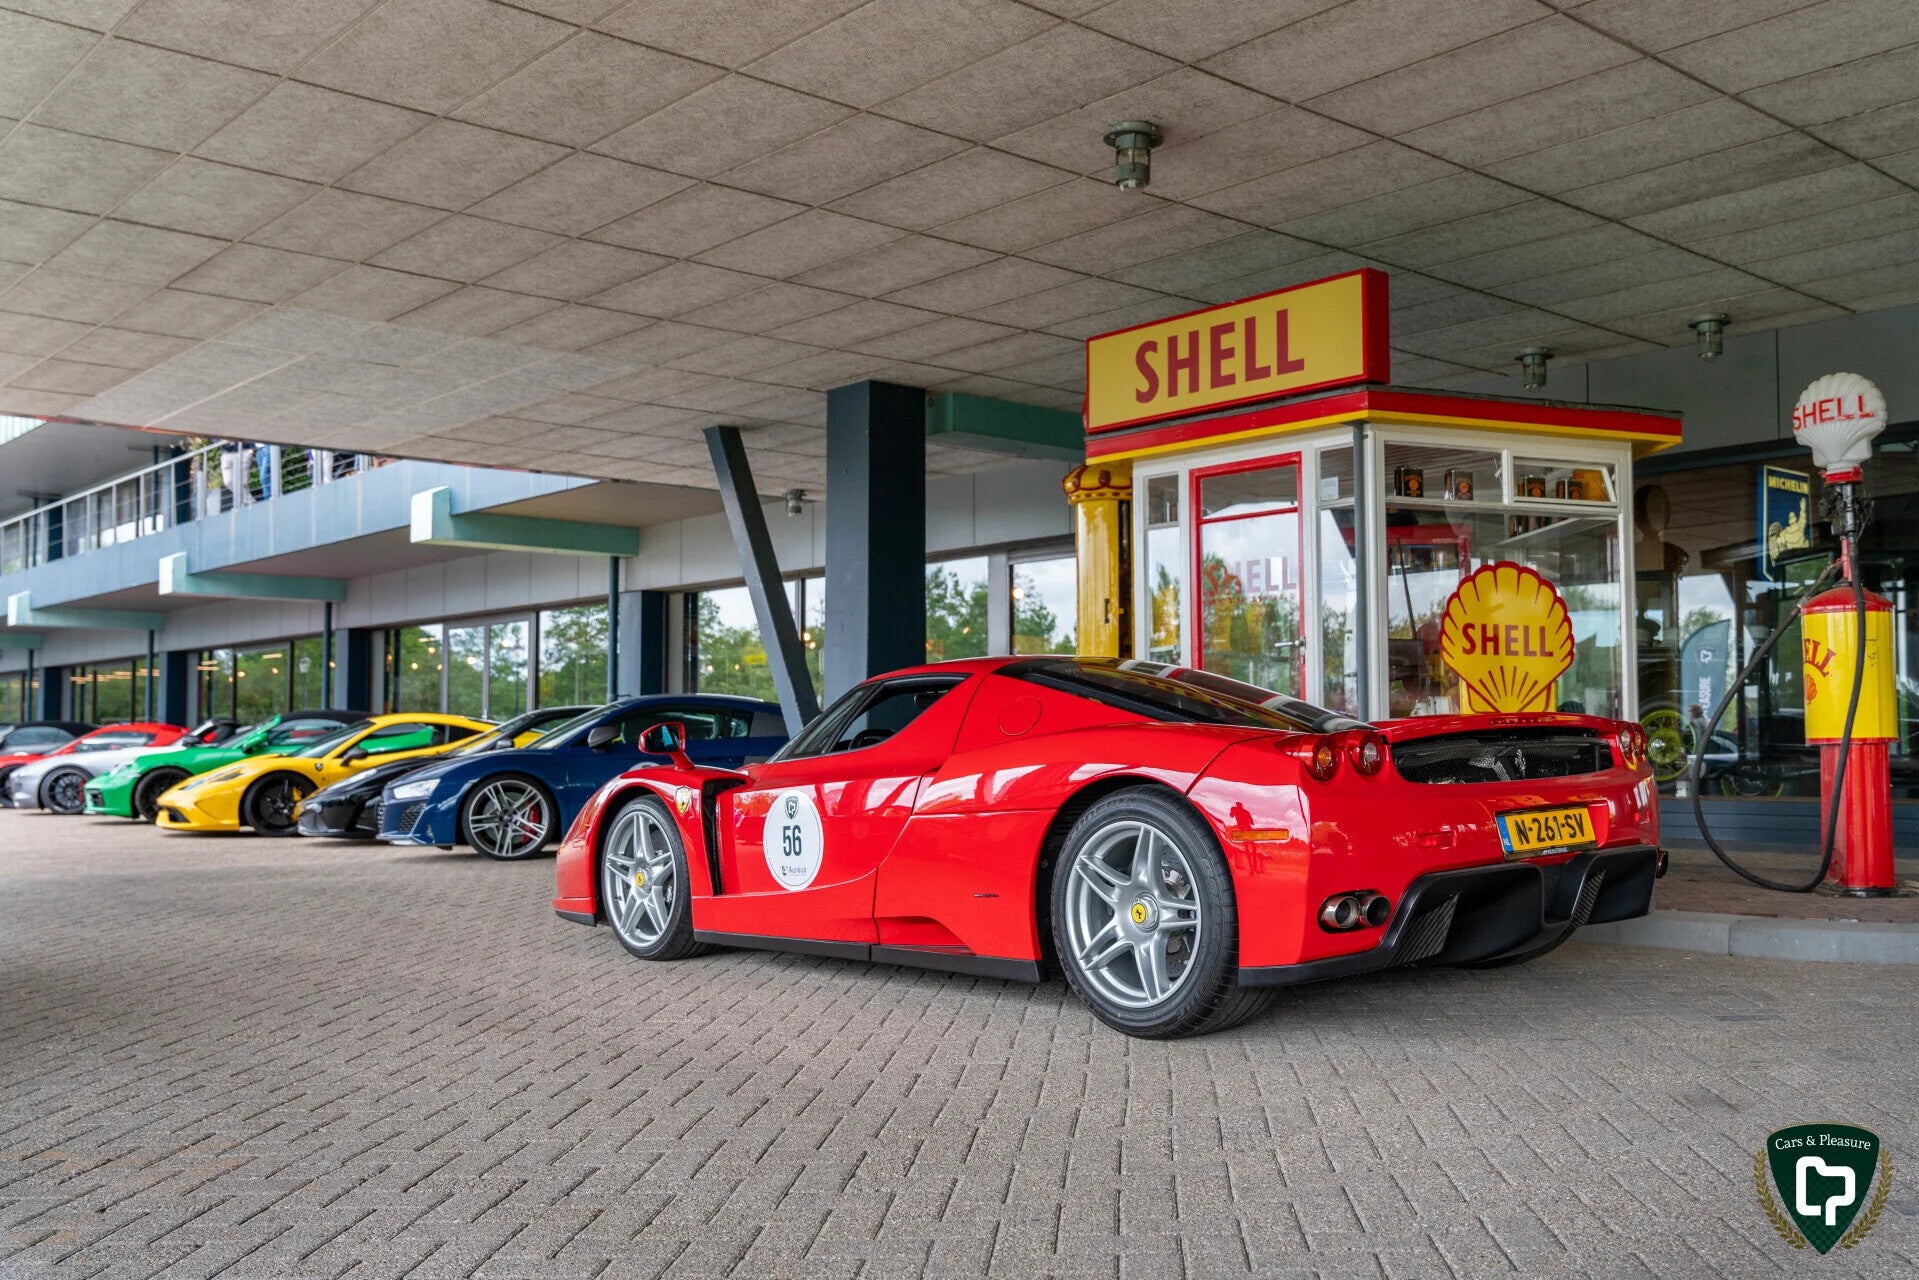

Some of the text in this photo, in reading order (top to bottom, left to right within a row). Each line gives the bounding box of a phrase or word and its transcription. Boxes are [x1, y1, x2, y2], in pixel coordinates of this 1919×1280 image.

[1135, 308, 1305, 404] SHELL
[1792, 395, 1875, 431] SHELL
[1768, 475, 1808, 495] MICHELIN
[1206, 556, 1297, 597] SHELL
[1461, 622, 1554, 658] SHELL
[1803, 638, 1836, 678] ELL
[783, 825, 802, 857] 56
[1514, 812, 1585, 845] N-261-SV
